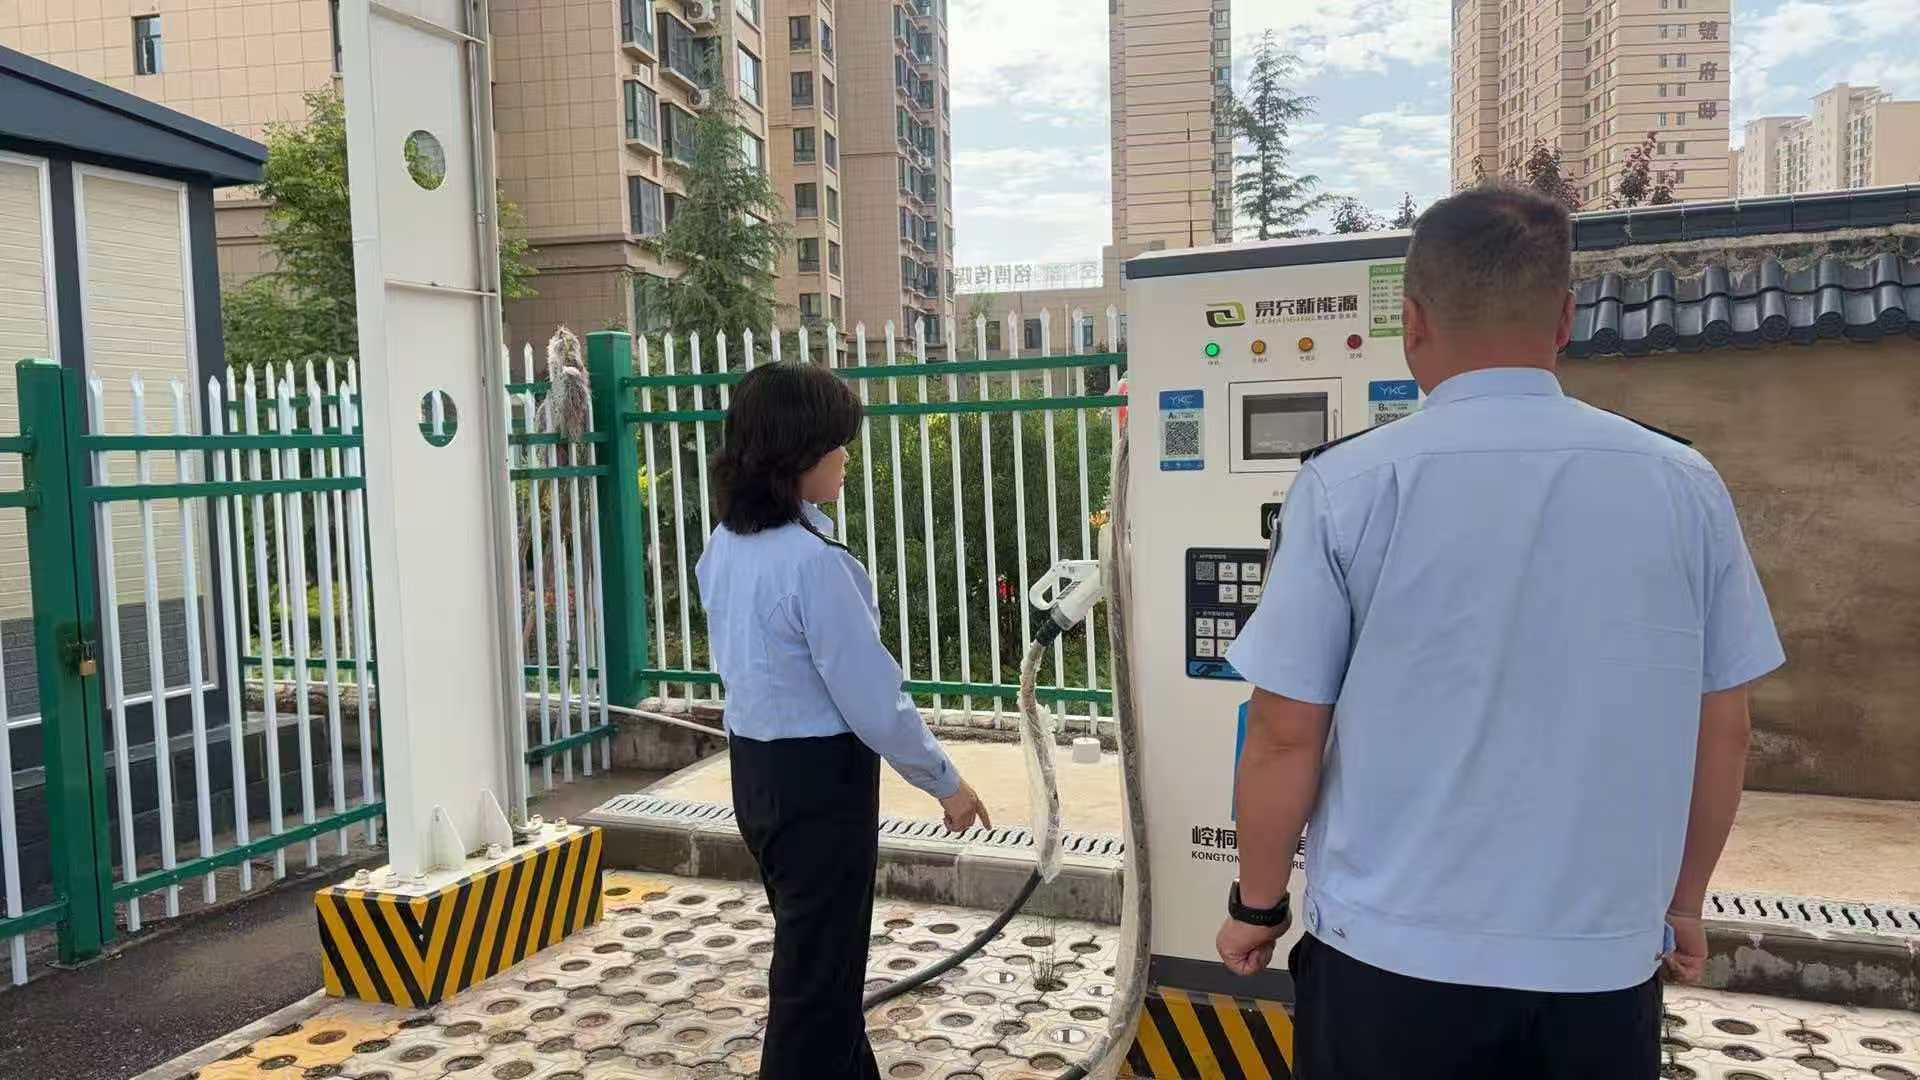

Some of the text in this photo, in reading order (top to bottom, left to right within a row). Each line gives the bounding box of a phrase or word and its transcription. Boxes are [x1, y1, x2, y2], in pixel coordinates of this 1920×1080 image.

[1256, 295, 1358, 317] 易充新能源
